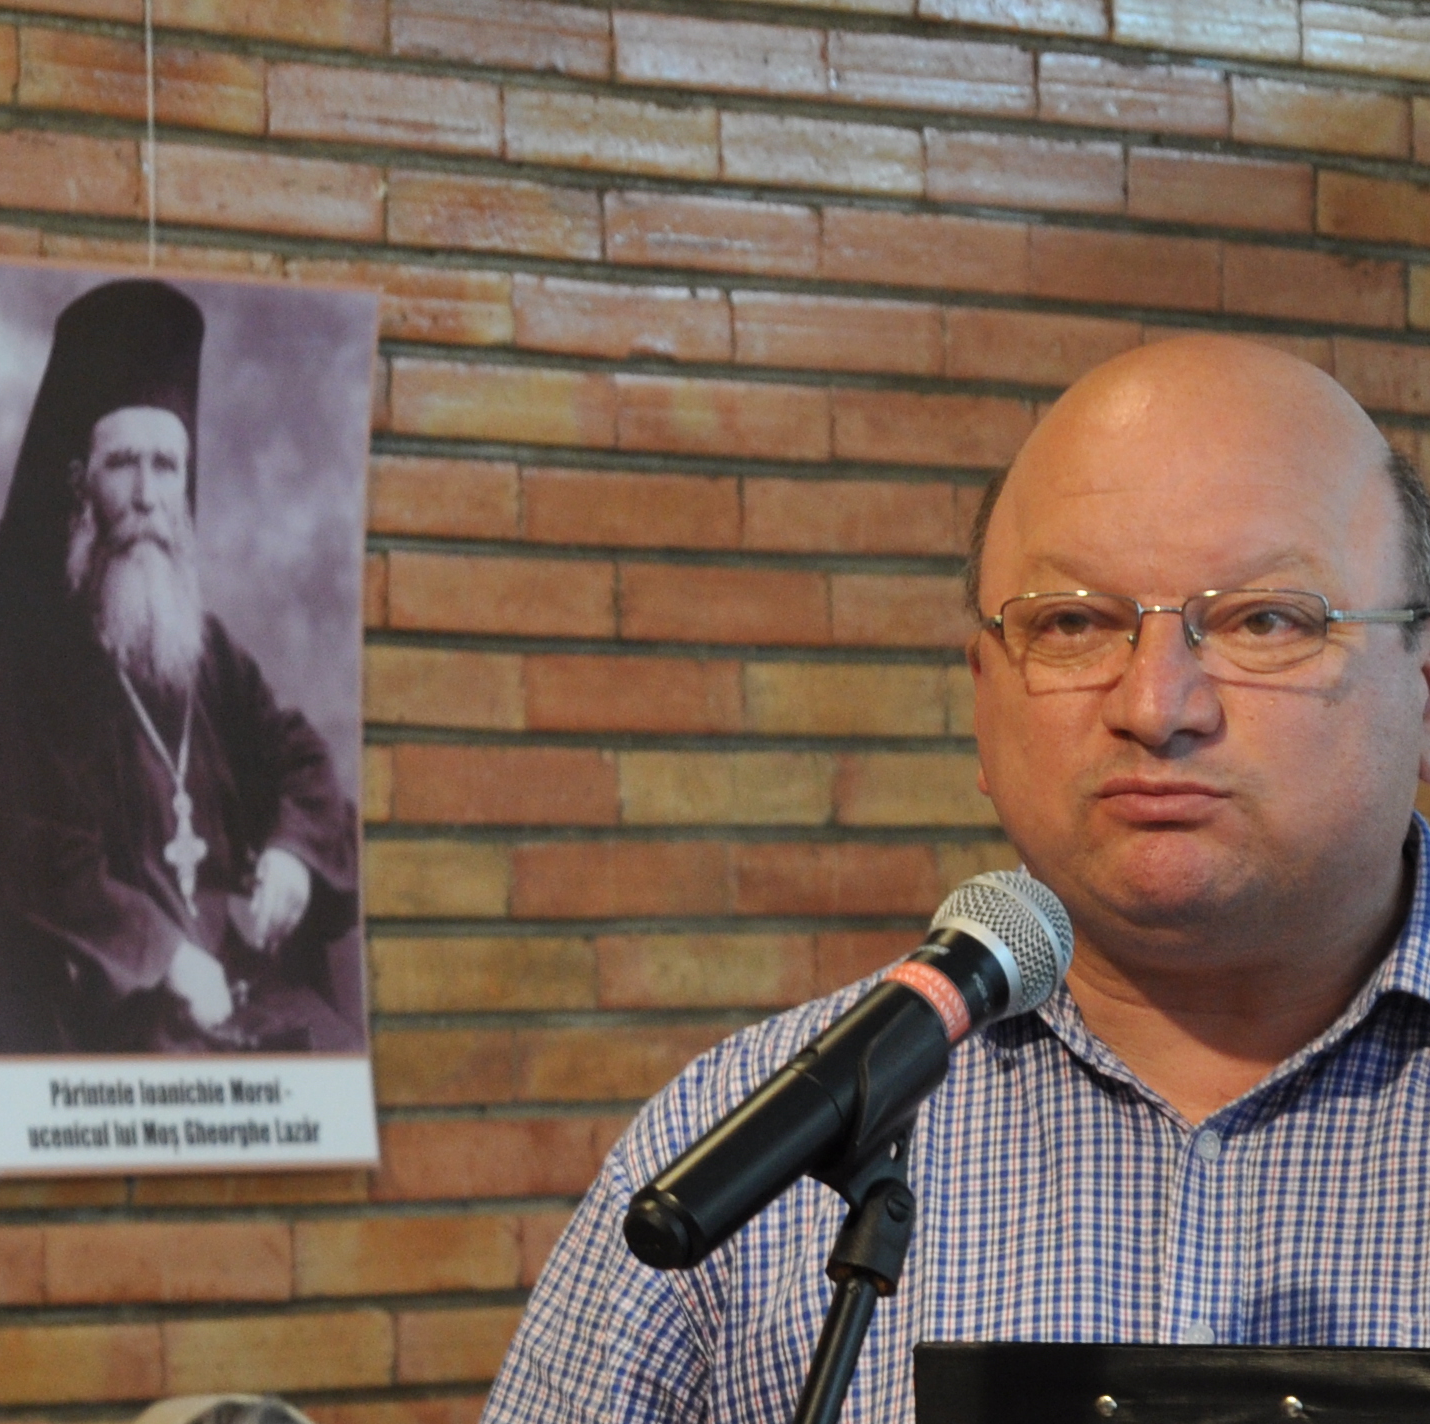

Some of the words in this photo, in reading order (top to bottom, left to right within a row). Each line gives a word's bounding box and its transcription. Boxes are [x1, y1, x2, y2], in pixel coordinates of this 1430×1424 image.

[28, 1121, 111, 1149] ucenicul
[113, 1120, 138, 1147] lui
[184, 1118, 271, 1148] Gheorghe
